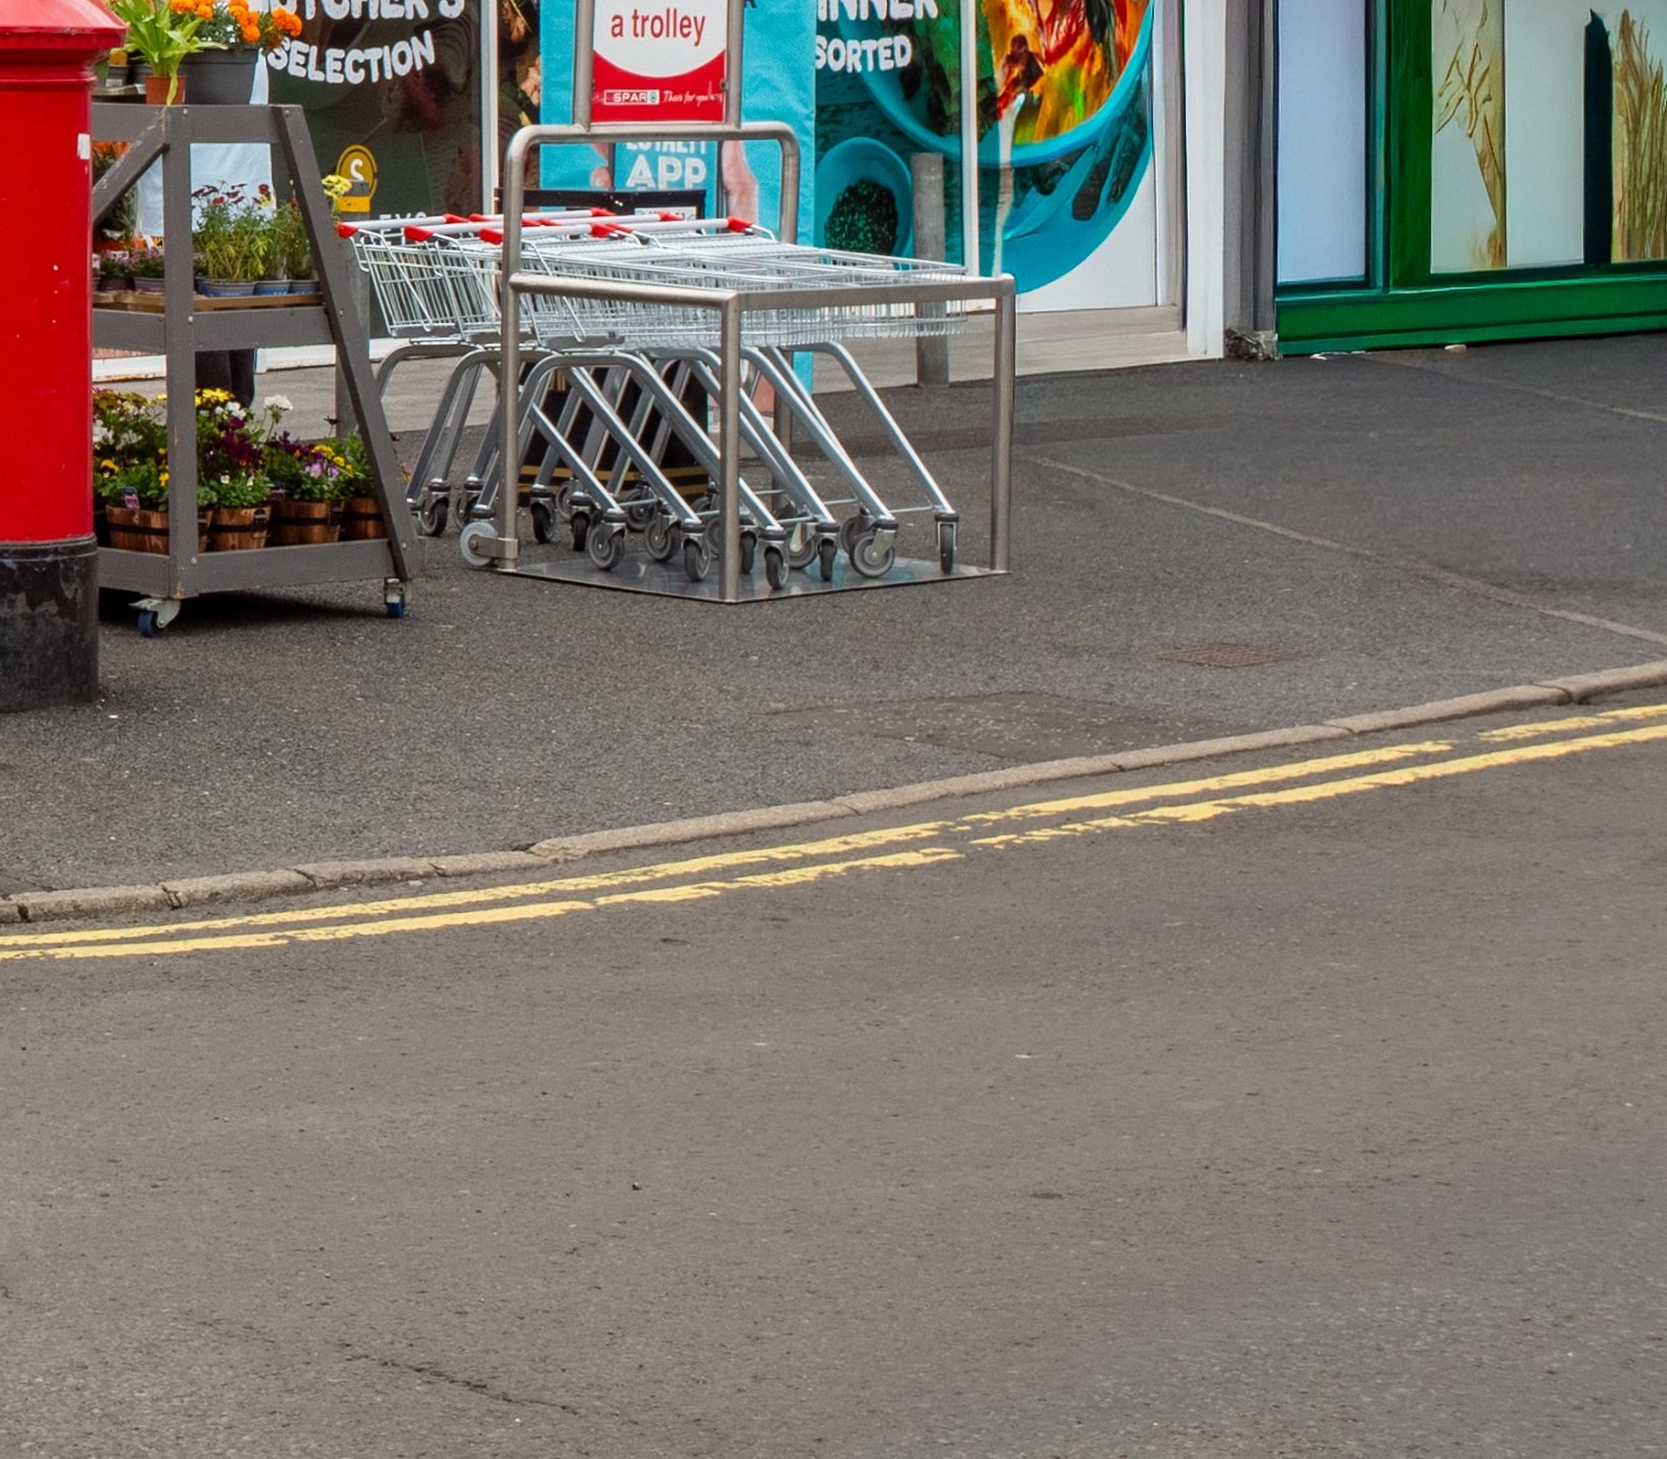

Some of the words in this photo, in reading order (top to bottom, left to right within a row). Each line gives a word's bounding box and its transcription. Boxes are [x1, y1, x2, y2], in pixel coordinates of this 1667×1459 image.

[611, 14, 624, 38] a
[632, 8, 706, 47] trolley
[266, 30, 436, 85] SELECTION
[816, 35, 913, 73] SORTED
[612, 93, 647, 103] SPAR
[626, 154, 707, 192] APP
